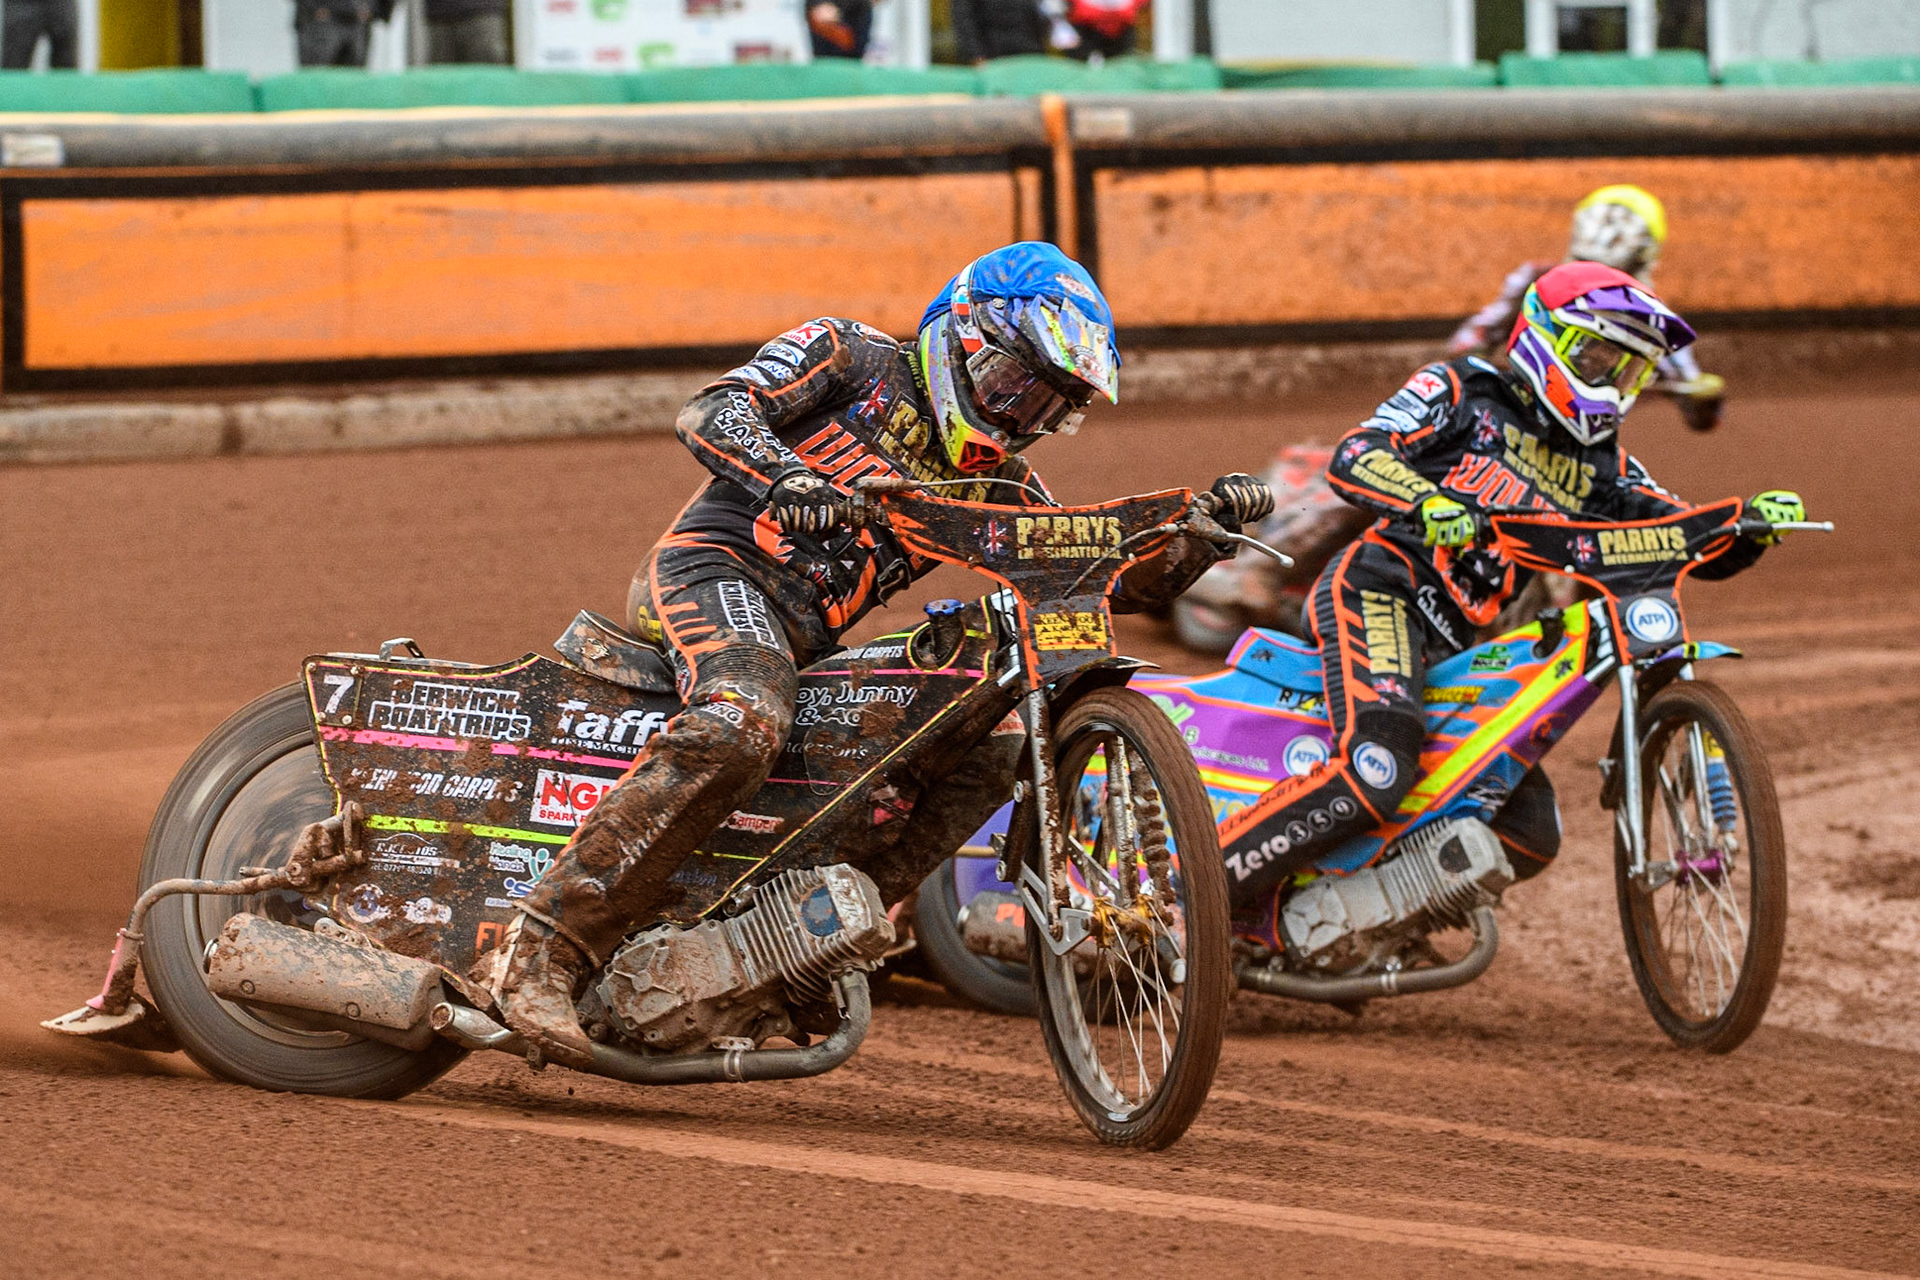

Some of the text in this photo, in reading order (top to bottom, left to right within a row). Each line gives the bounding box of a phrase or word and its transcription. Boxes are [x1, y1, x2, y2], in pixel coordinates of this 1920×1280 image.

[1016, 516, 1123, 546] PARRYS
[1597, 525, 1688, 555] PARRYS
[1638, 612, 1668, 626] ATPI
[323, 675, 355, 715] 7
[367, 700, 533, 743] BOAT TRIPS
[1363, 755, 1389, 775] ATPI
[538, 808, 578, 822] SPARK
